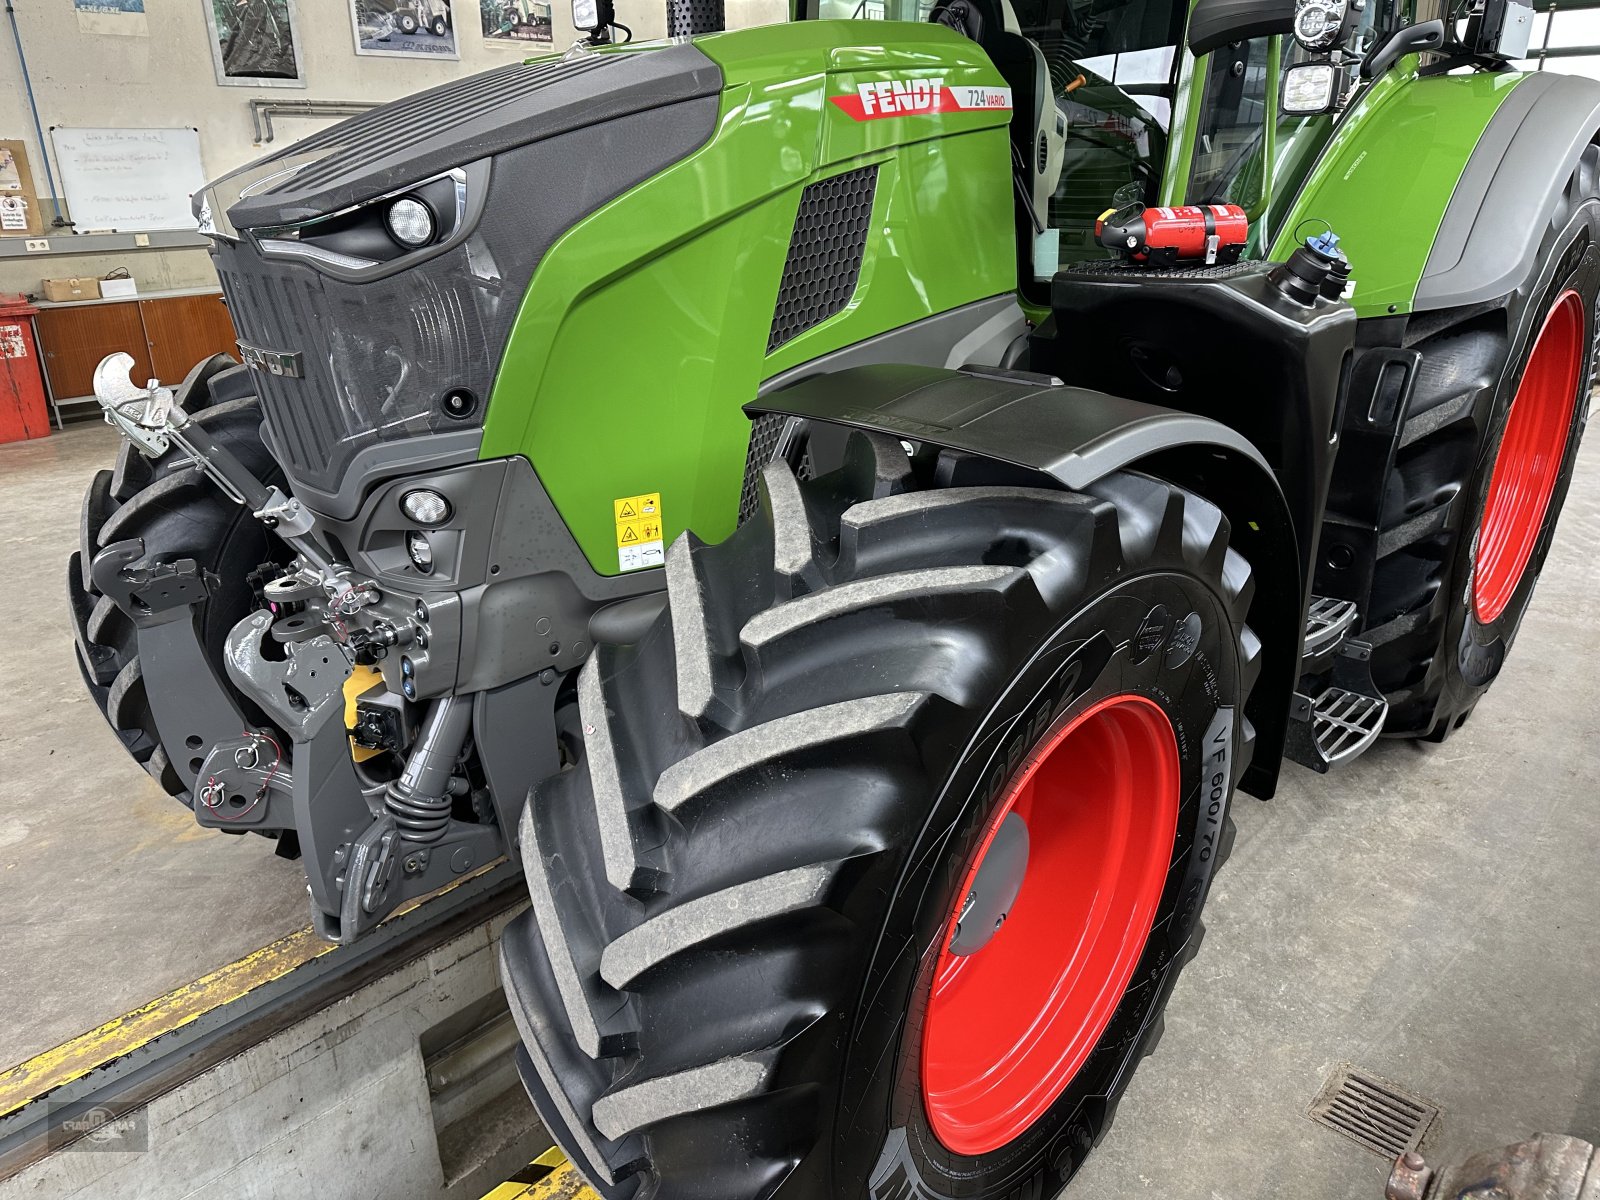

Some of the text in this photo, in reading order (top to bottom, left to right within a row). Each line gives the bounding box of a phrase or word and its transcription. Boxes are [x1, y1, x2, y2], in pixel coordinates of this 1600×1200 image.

[857, 78, 1006, 116] FENDT 724 VARIO
[1050, 659, 1083, 725] 2
[1212, 726, 1226, 762] VF
